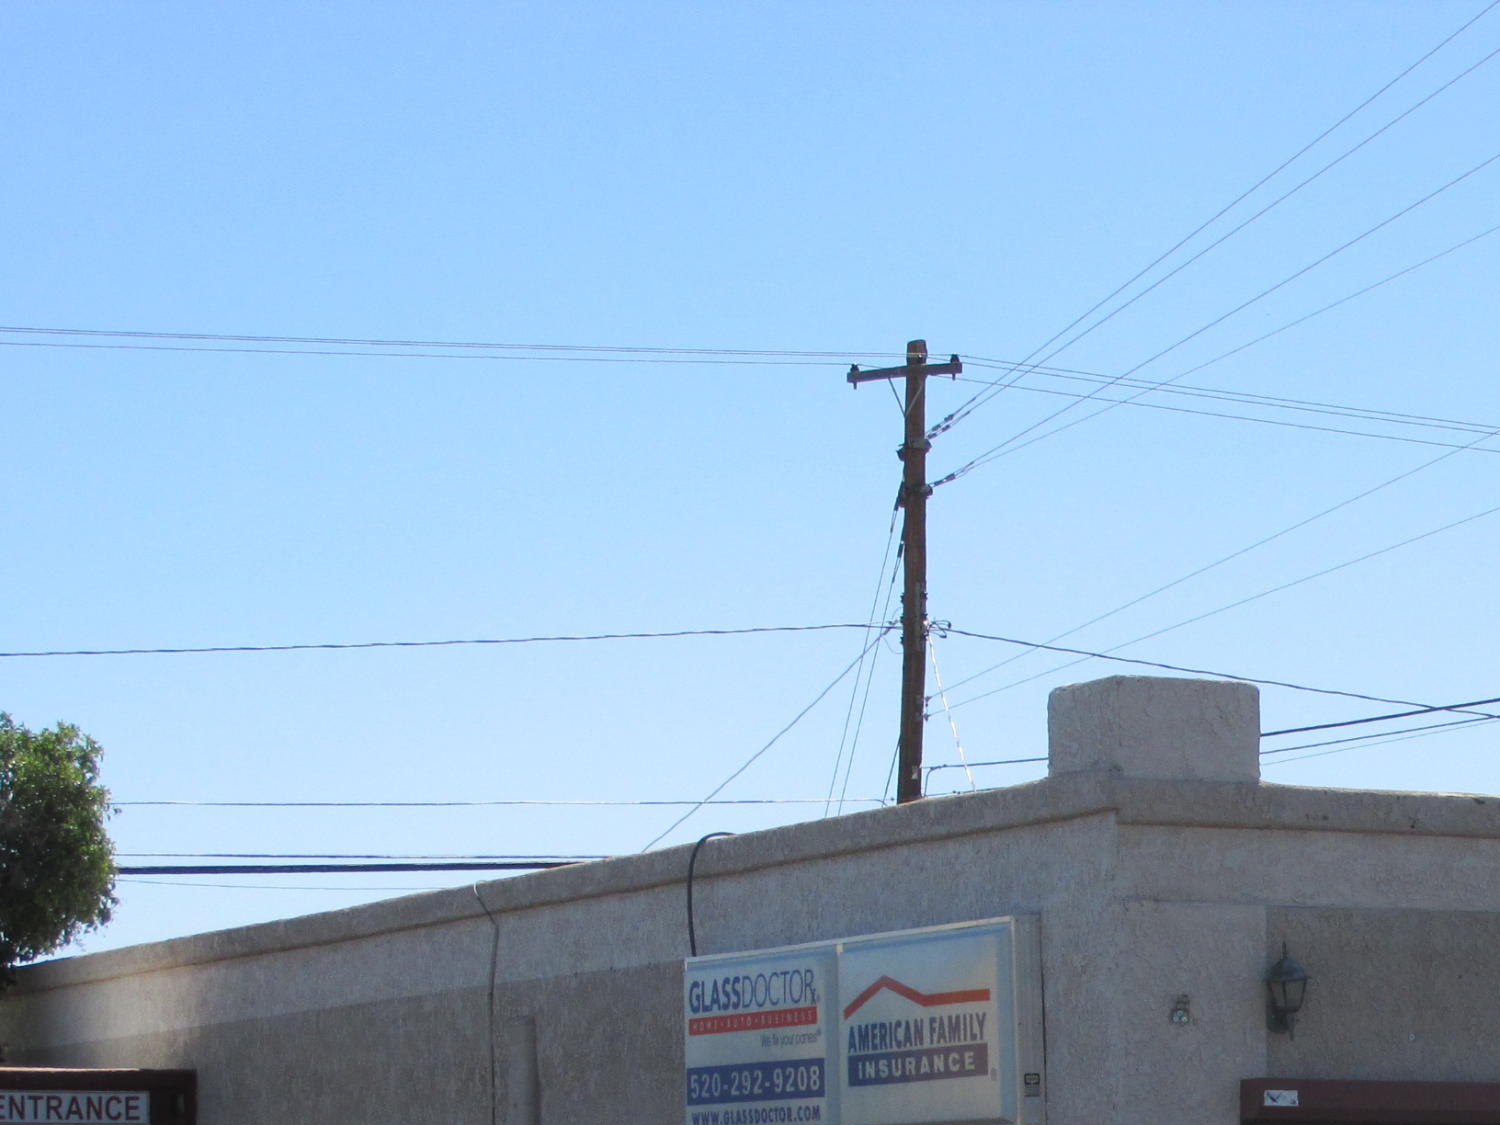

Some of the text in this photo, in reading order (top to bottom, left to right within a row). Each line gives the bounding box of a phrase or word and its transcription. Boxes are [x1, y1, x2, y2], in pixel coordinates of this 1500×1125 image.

[848, 1012, 987, 1053] AMERICAN FAMILY
[858, 1051, 976, 1080] INSURANCE
[690, 1066, 820, 1099] 520-292-9208
